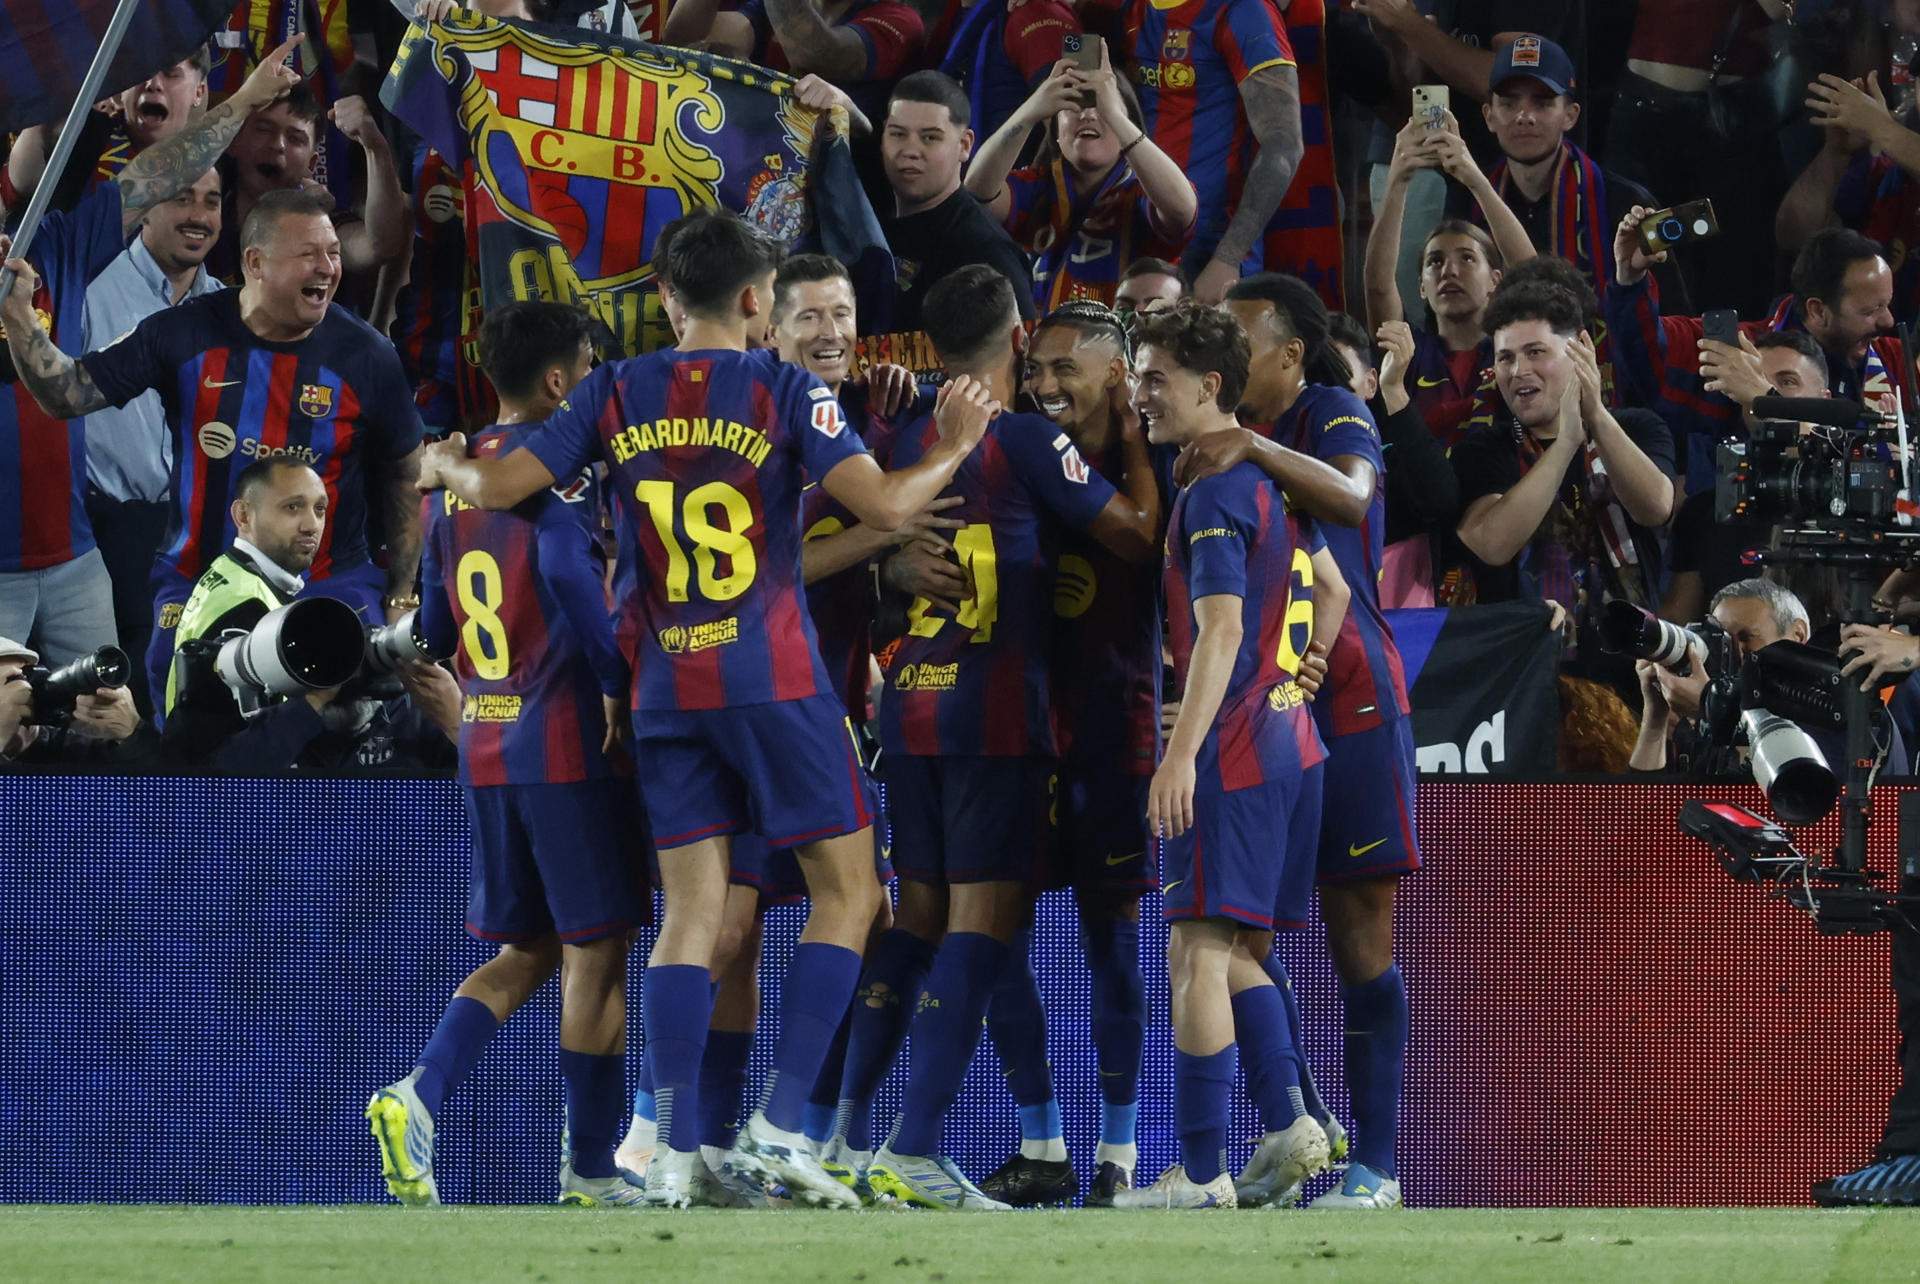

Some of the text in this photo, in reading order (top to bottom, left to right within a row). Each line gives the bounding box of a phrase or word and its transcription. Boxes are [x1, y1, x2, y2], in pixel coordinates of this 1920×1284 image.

[610, 417, 773, 469] GERARD MARTÍN
[635, 480, 757, 602] 18
[457, 550, 510, 681] 8
[688, 616, 738, 636] UNHCR
[1276, 548, 1314, 677] 6
[688, 626, 738, 648] ACNUR
[477, 705, 520, 718] ACNUR
[478, 695, 523, 706] UNHCR
